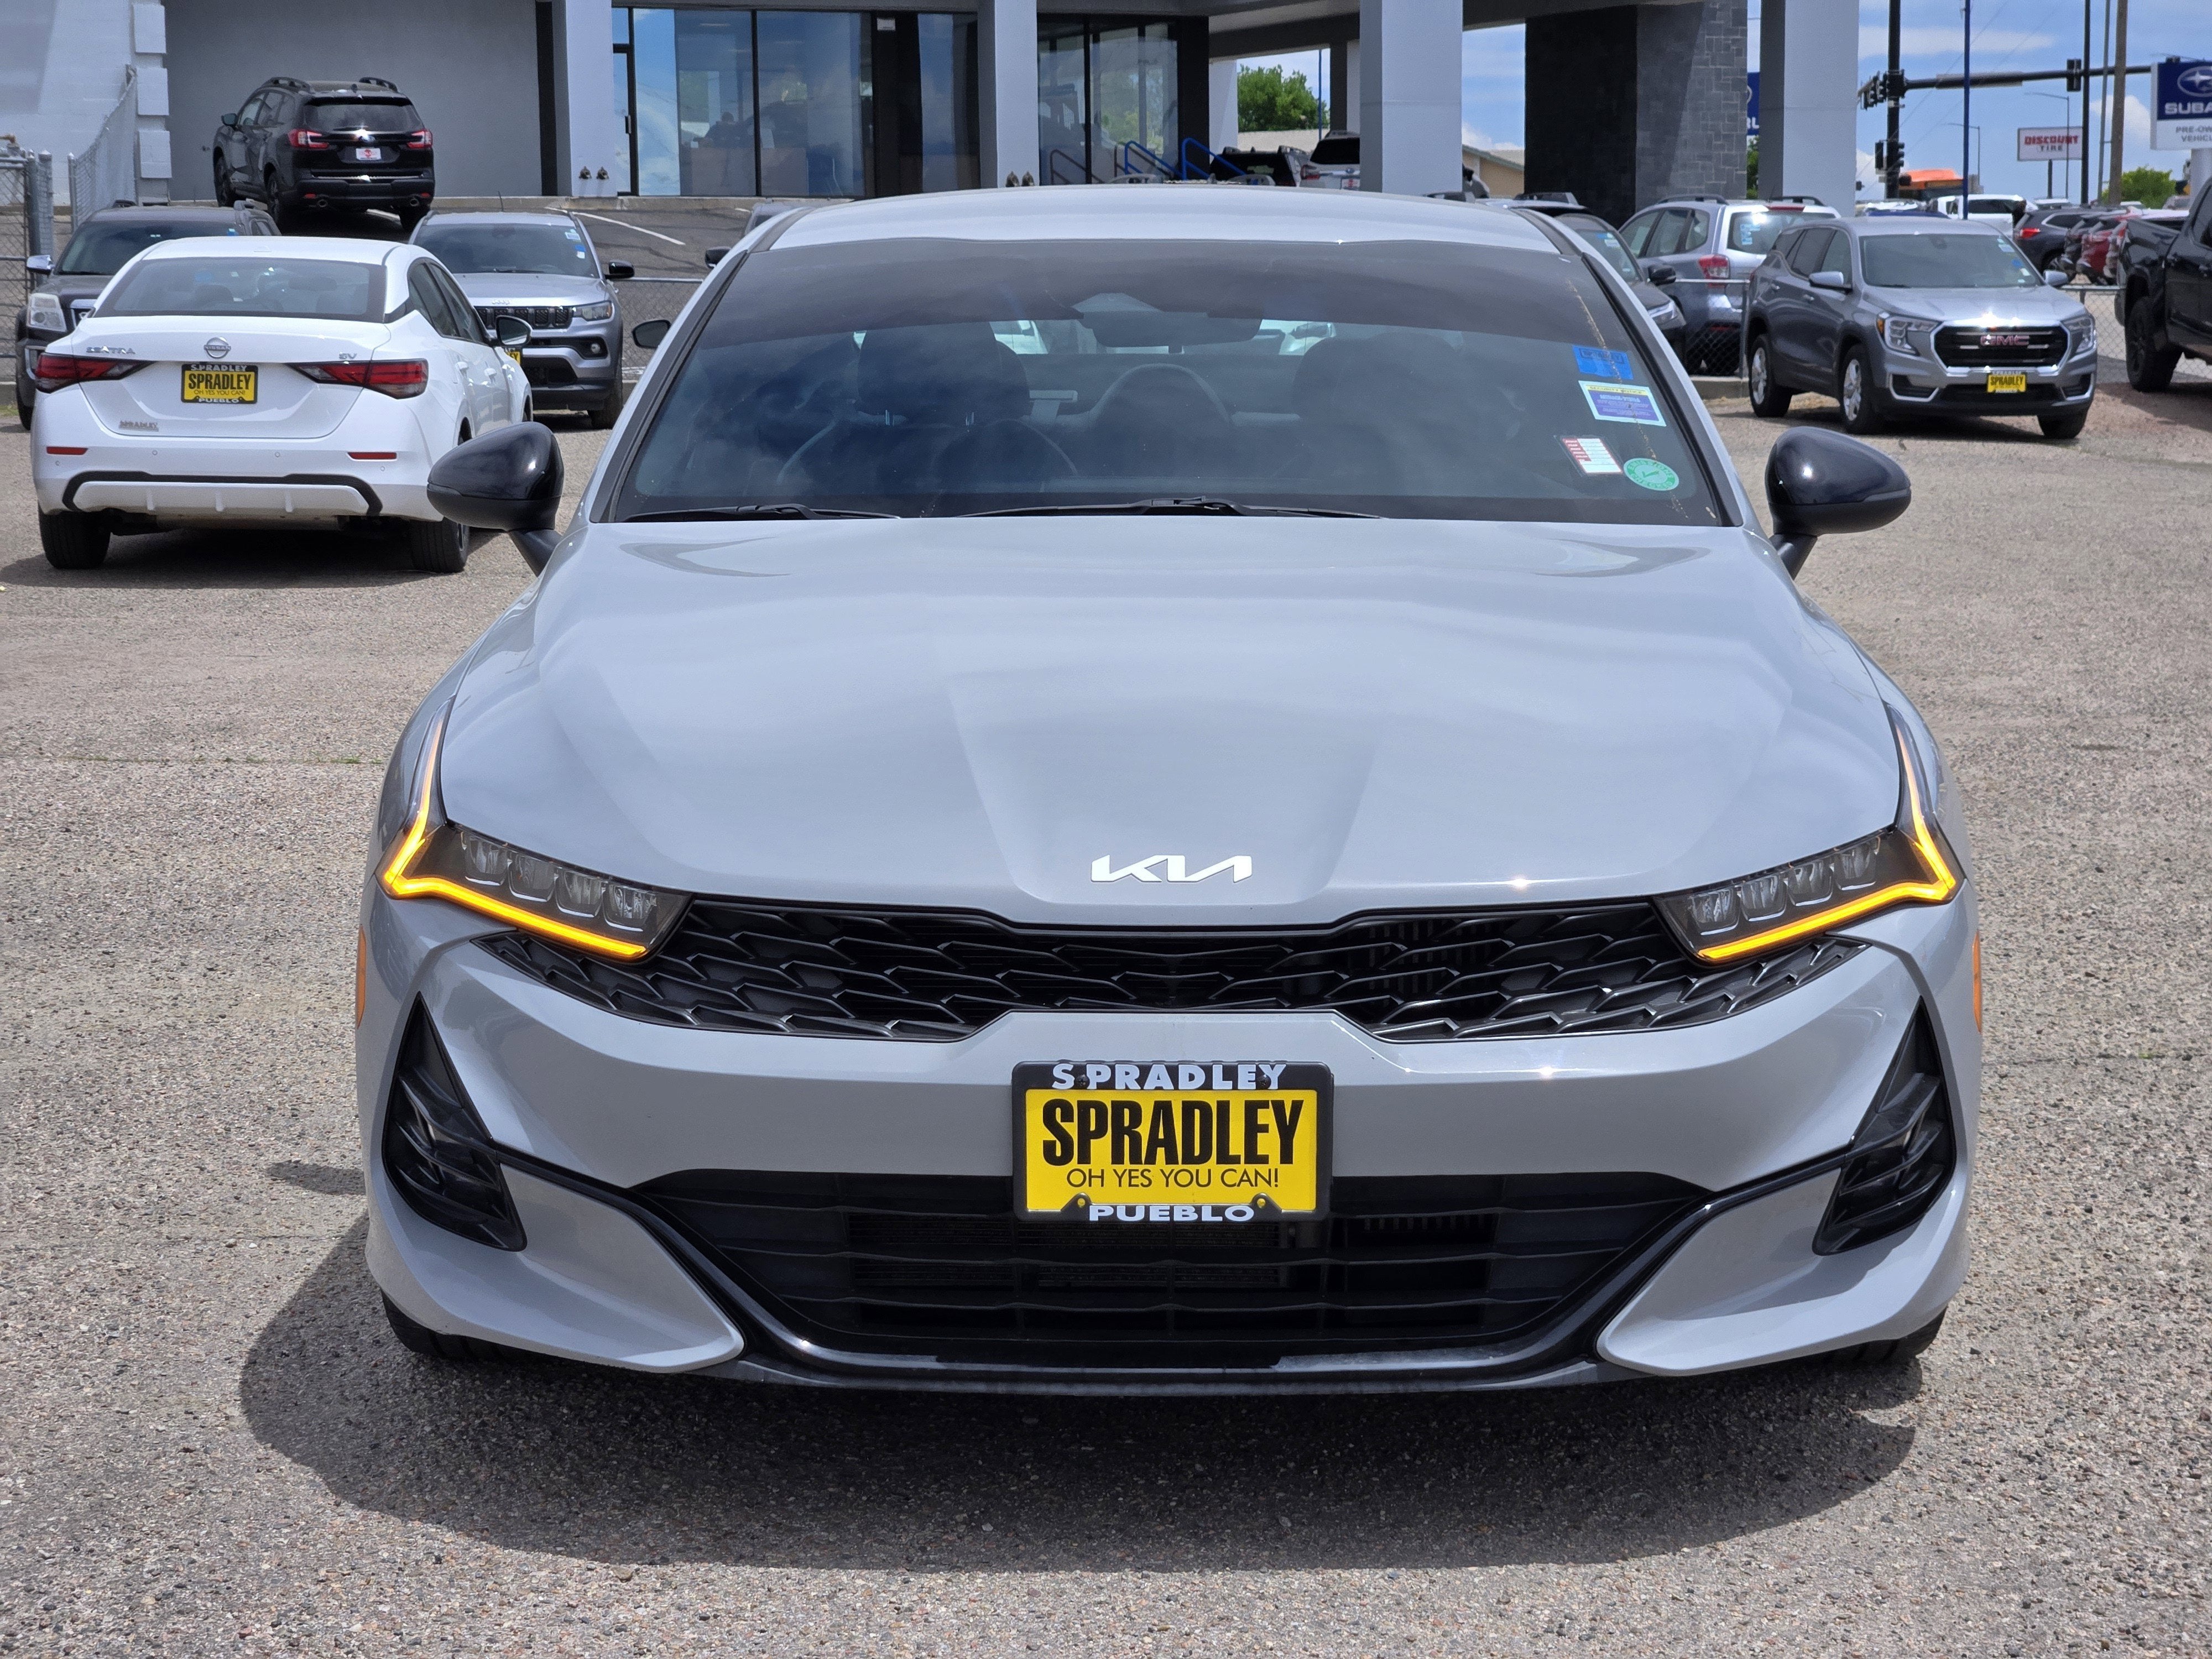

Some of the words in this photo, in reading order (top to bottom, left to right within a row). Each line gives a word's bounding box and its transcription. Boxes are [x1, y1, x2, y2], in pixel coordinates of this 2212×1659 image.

[2024, 135, 2078, 145] DISCOUNT
[1980, 335, 2030, 346] GMC
[188, 373, 251, 390] SPRADLEY
[1990, 377, 2023, 385] SPRADLEY
[1091, 854, 1253, 883] KIA
[1052, 1063, 1287, 1090] SPRADLEY
[1042, 1098, 1304, 1166] SPRADLEY
[1066, 1168, 1104, 1188] OH
[1112, 1168, 1152, 1188] YES
[1159, 1168, 1211, 1188] YOU
[1220, 1168, 1279, 1188] CAN!
[1089, 1205, 1254, 1222] PUEBLO
